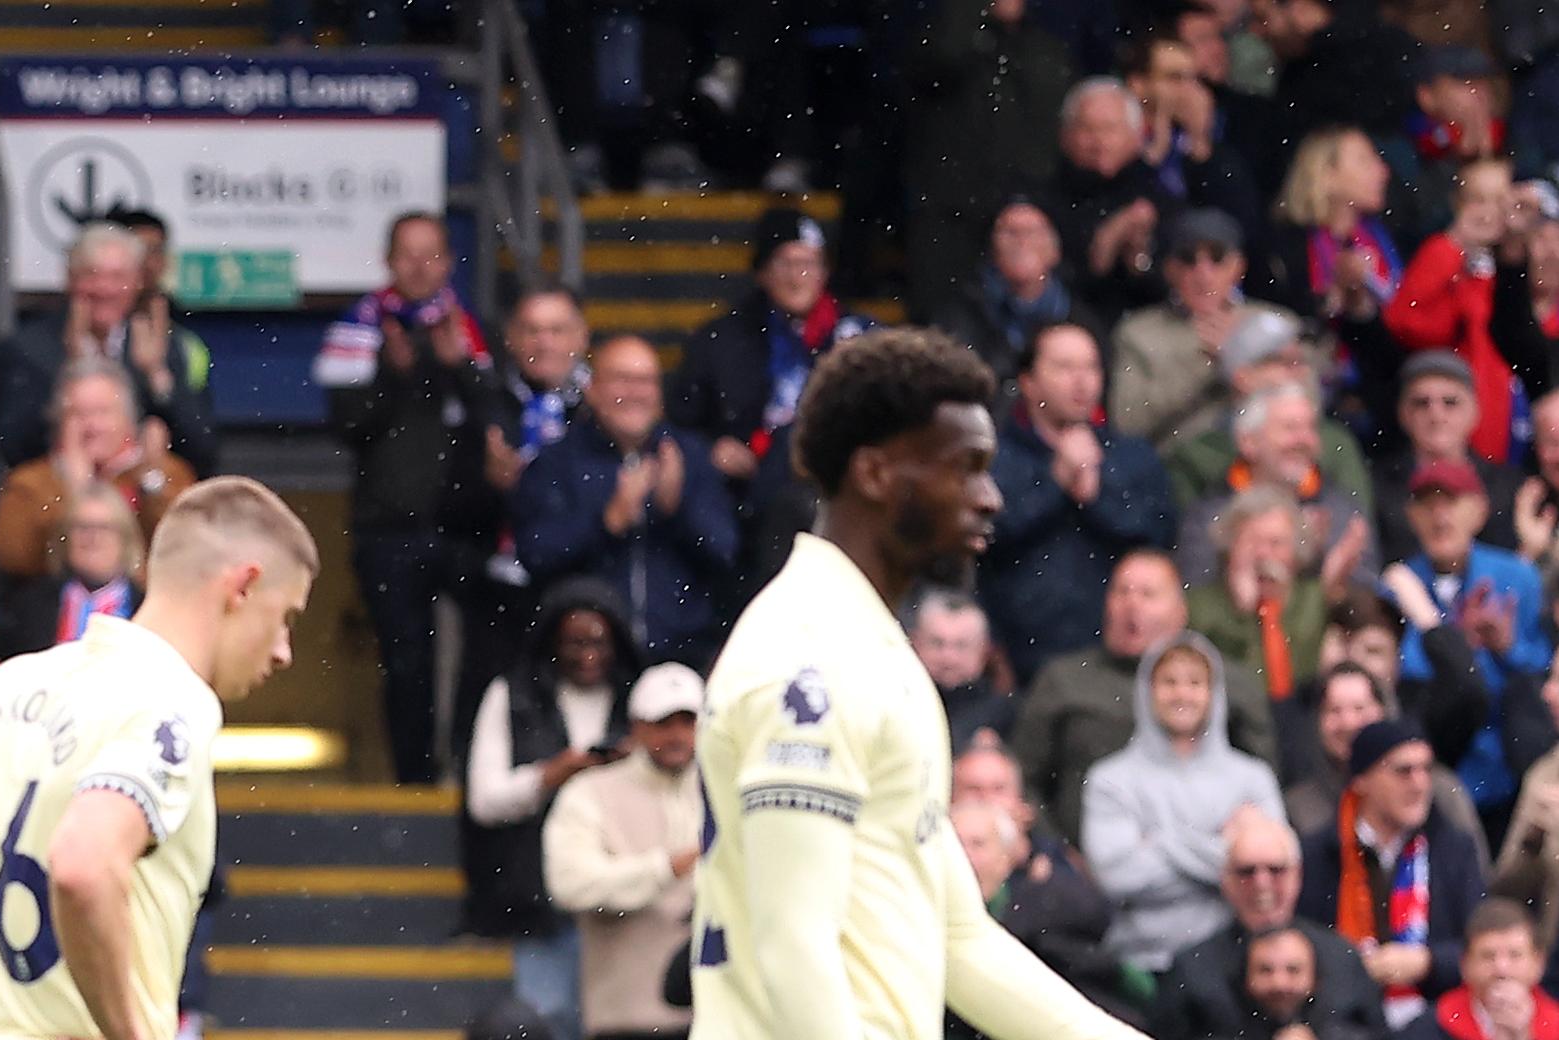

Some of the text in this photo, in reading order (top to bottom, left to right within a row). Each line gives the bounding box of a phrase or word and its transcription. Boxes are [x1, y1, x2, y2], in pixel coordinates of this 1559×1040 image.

[18, 66, 419, 115] Wright & Bright Lounge
